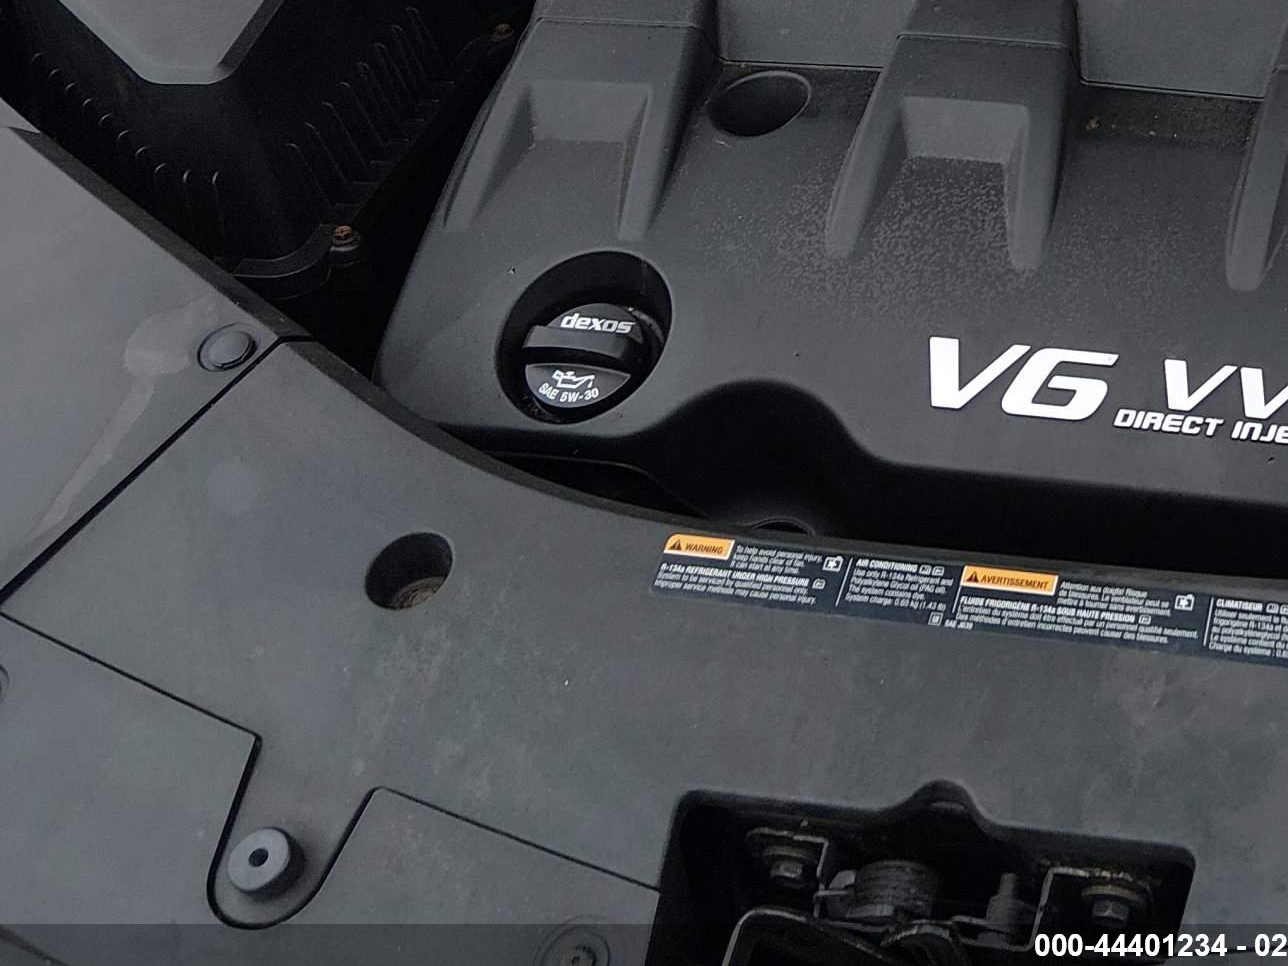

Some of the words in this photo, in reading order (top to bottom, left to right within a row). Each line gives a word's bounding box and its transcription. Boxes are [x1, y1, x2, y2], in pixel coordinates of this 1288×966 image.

[560, 313, 637, 334] dexos
[928, 336, 1120, 421] V6
[538, 382, 559, 401] SAE
[559, 386, 600, 403] 5W-30
[1113, 408, 1224, 438] DIRECT
[684, 540, 724, 555] WARNING
[685, 565, 732, 578] REFRIGERANT
[756, 573, 774, 583] HIGH
[773, 575, 810, 587] PRESSURE
[869, 559, 918, 573] CONDITIONING
[981, 574, 1048, 591] AVERTISSEMENT
[1216, 599, 1263, 612] CLIMATISEUR
